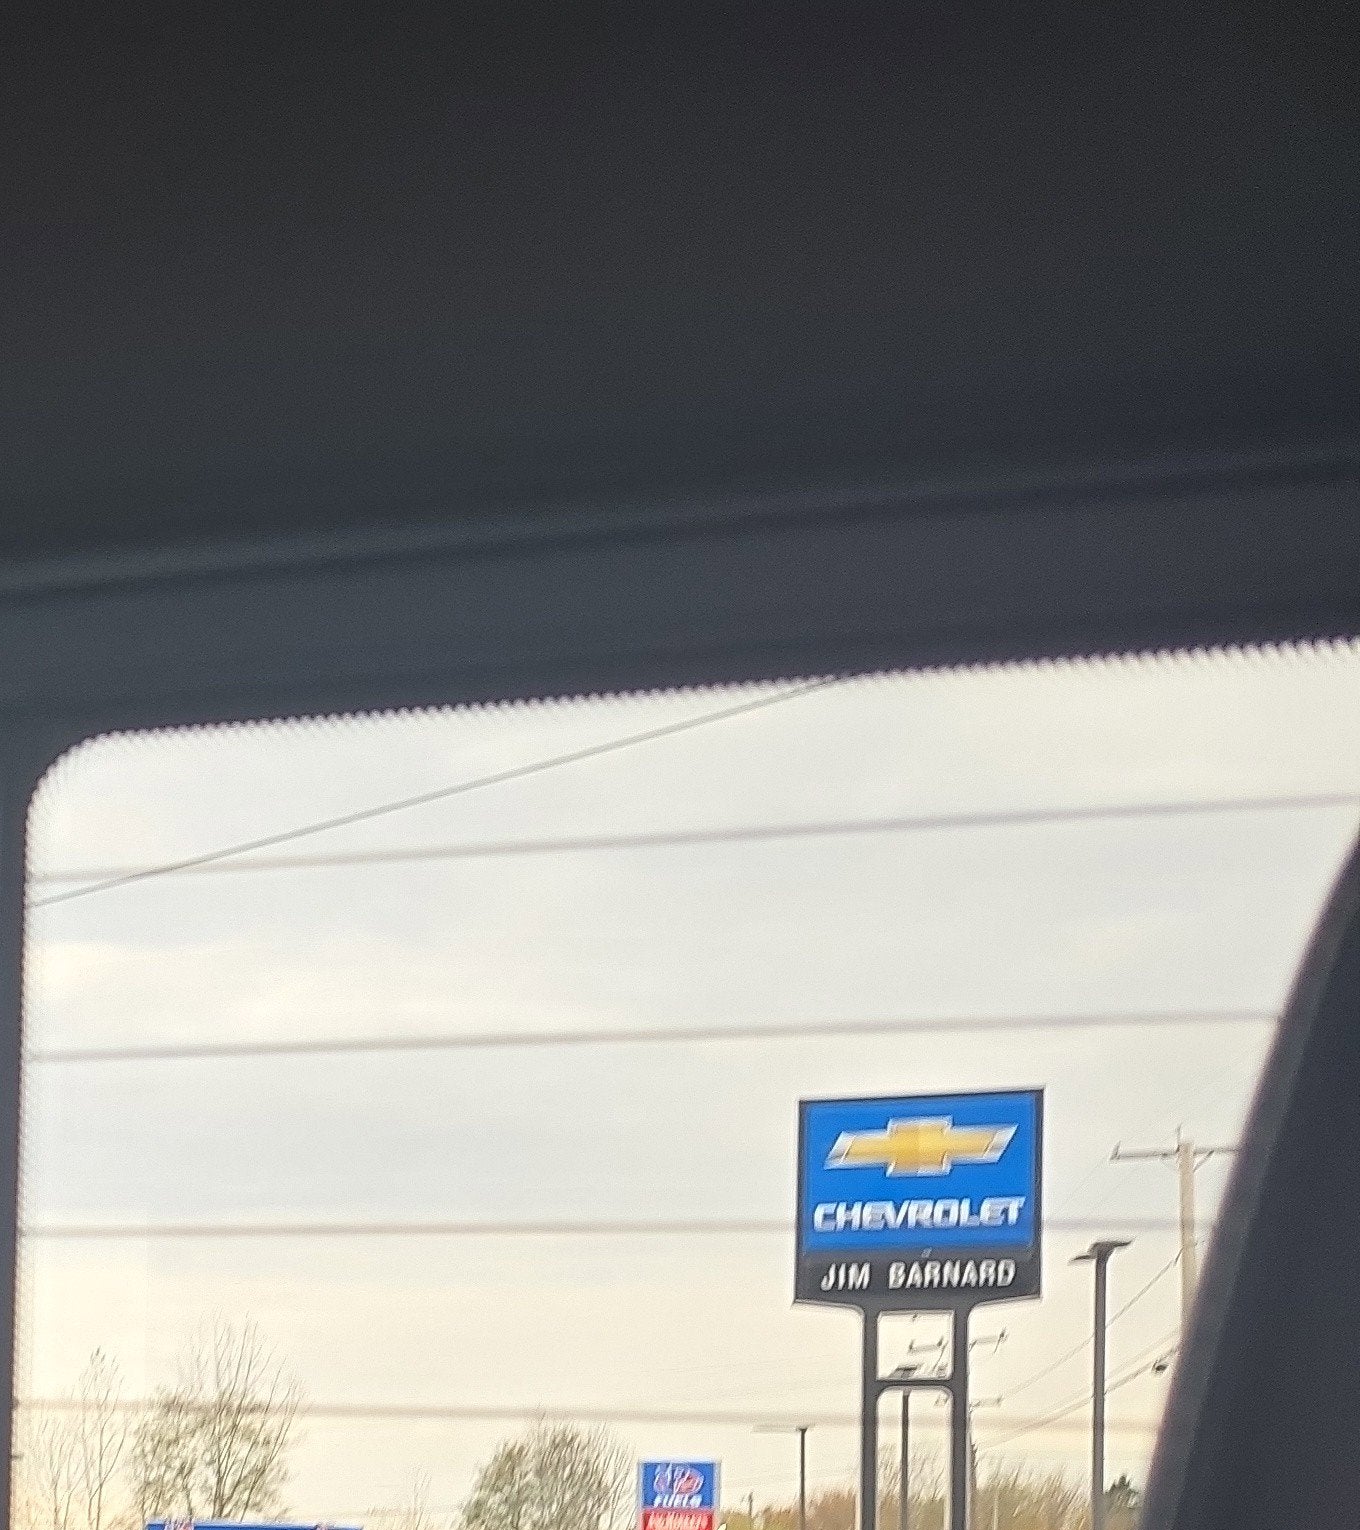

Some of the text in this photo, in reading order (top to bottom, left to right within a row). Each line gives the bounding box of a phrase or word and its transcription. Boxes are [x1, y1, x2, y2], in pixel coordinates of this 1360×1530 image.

[813, 1196, 1026, 1232] CHEVROLET
[820, 1258, 1017, 1291] JIM BARNARD
